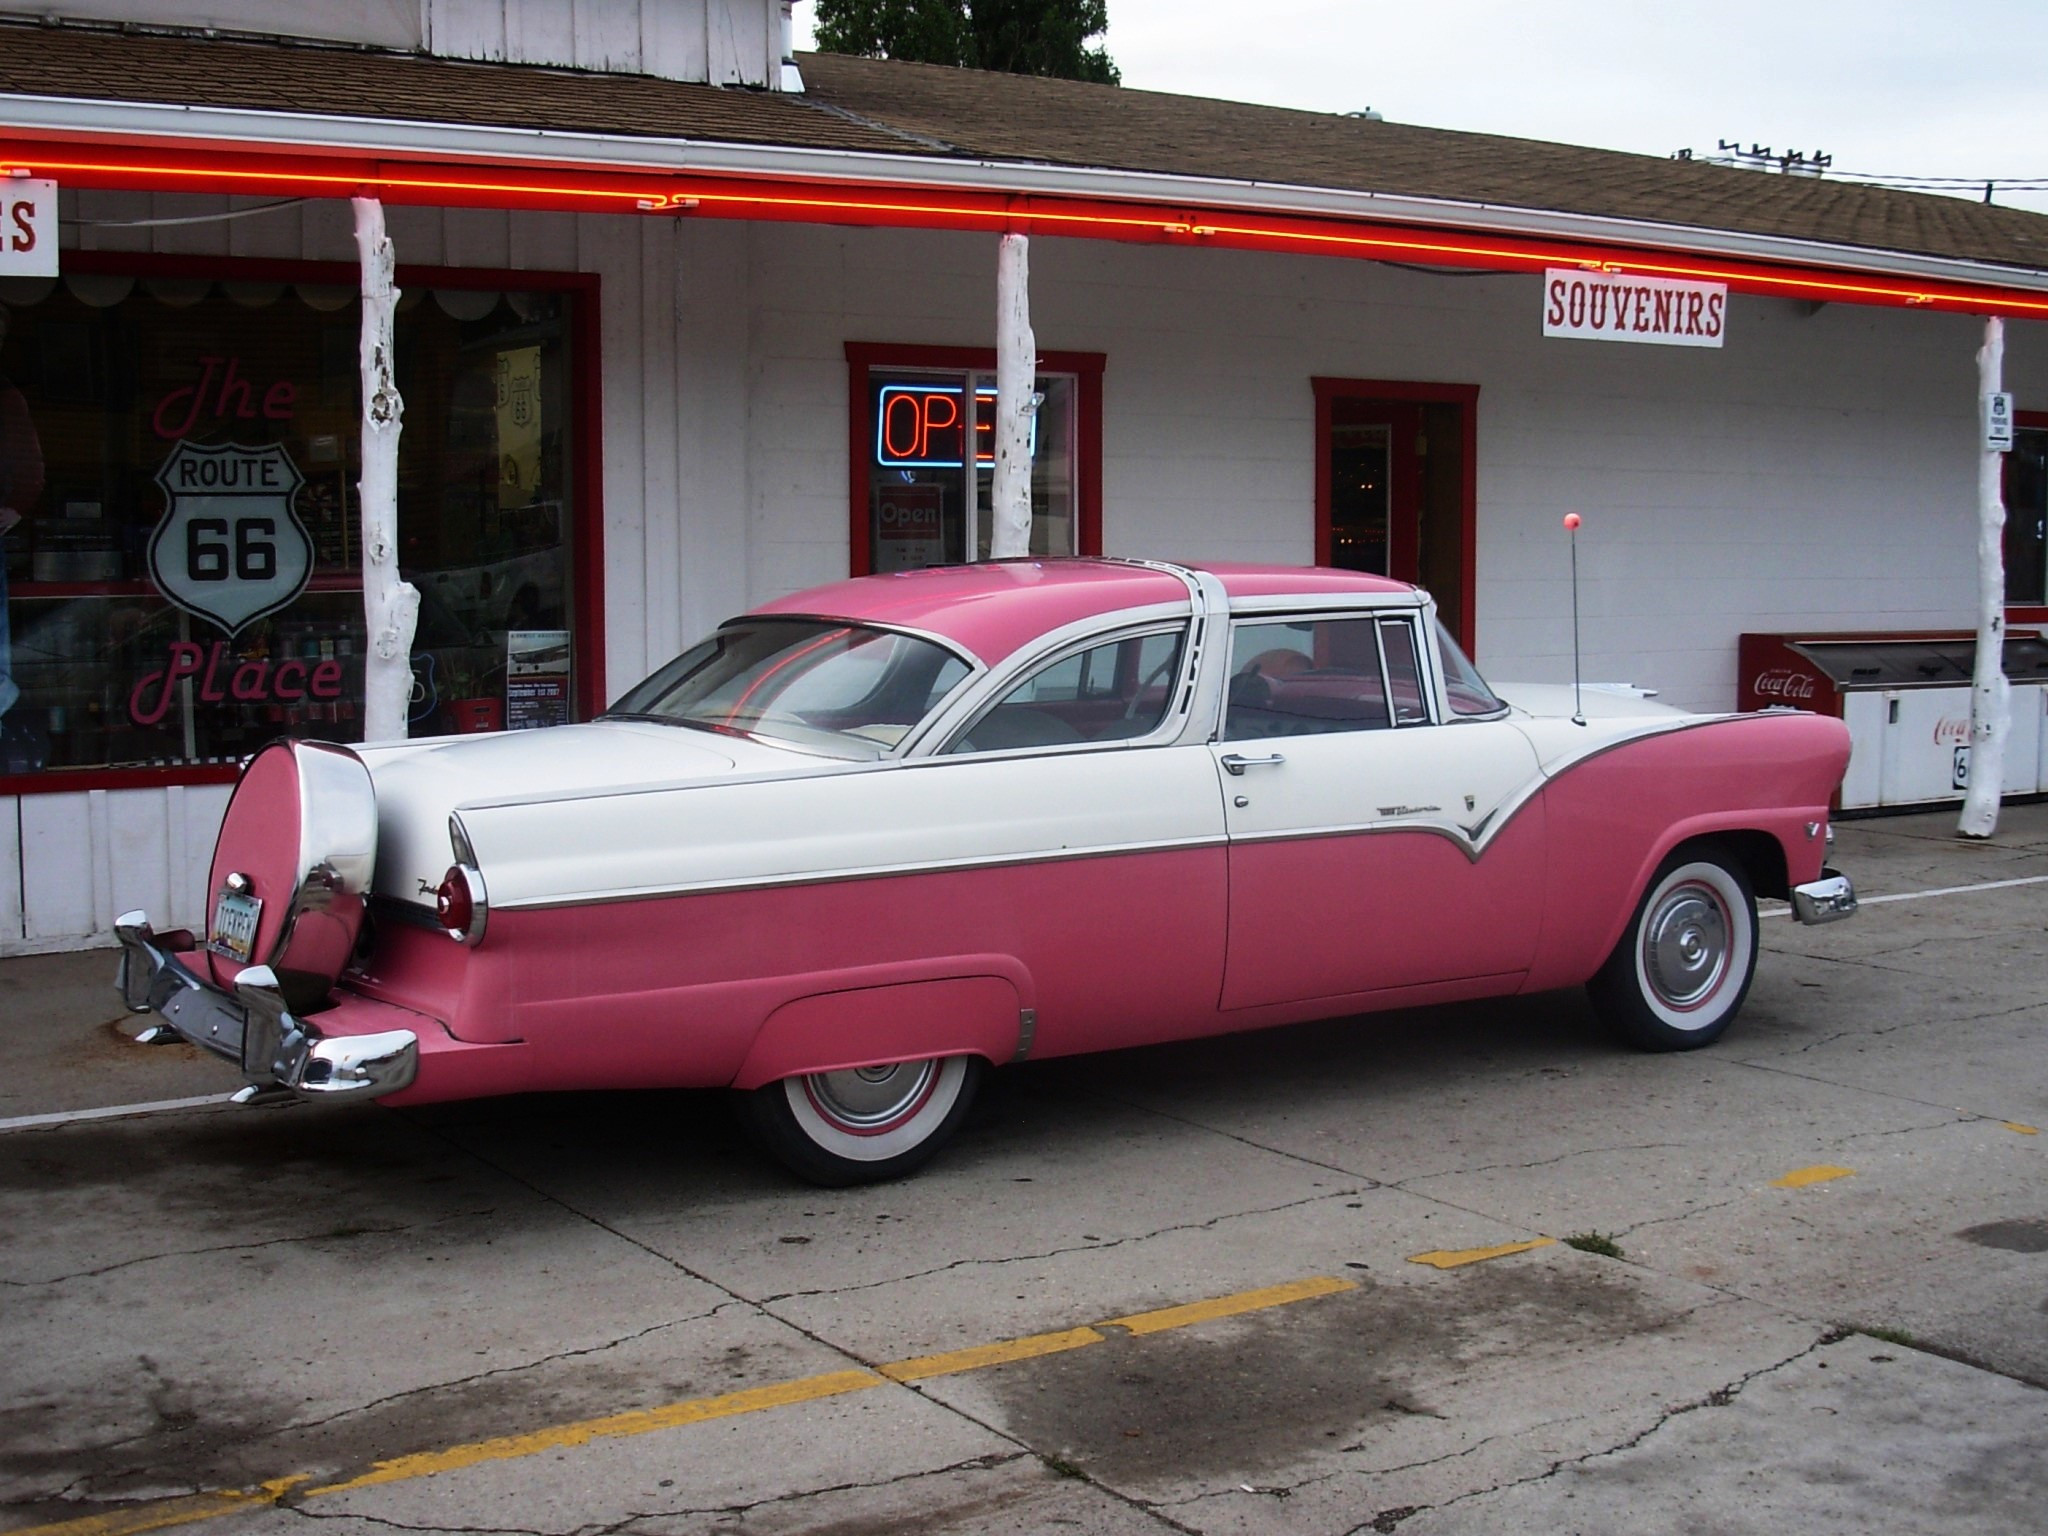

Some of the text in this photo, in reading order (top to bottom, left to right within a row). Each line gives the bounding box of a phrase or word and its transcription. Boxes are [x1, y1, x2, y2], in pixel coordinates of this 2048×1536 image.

[0, 200, 36, 253] S
[1547, 279, 1723, 338] SOUVENIRS
[152, 357, 297, 439] The
[885, 395, 994, 459] OPE
[180, 459, 279, 487] ROUTE
[881, 502, 937, 527] Open
[187, 518, 277, 581] 66
[129, 641, 343, 725] Place
[1934, 717, 1971, 745] Coca
[1957, 757, 1969, 778] 6
